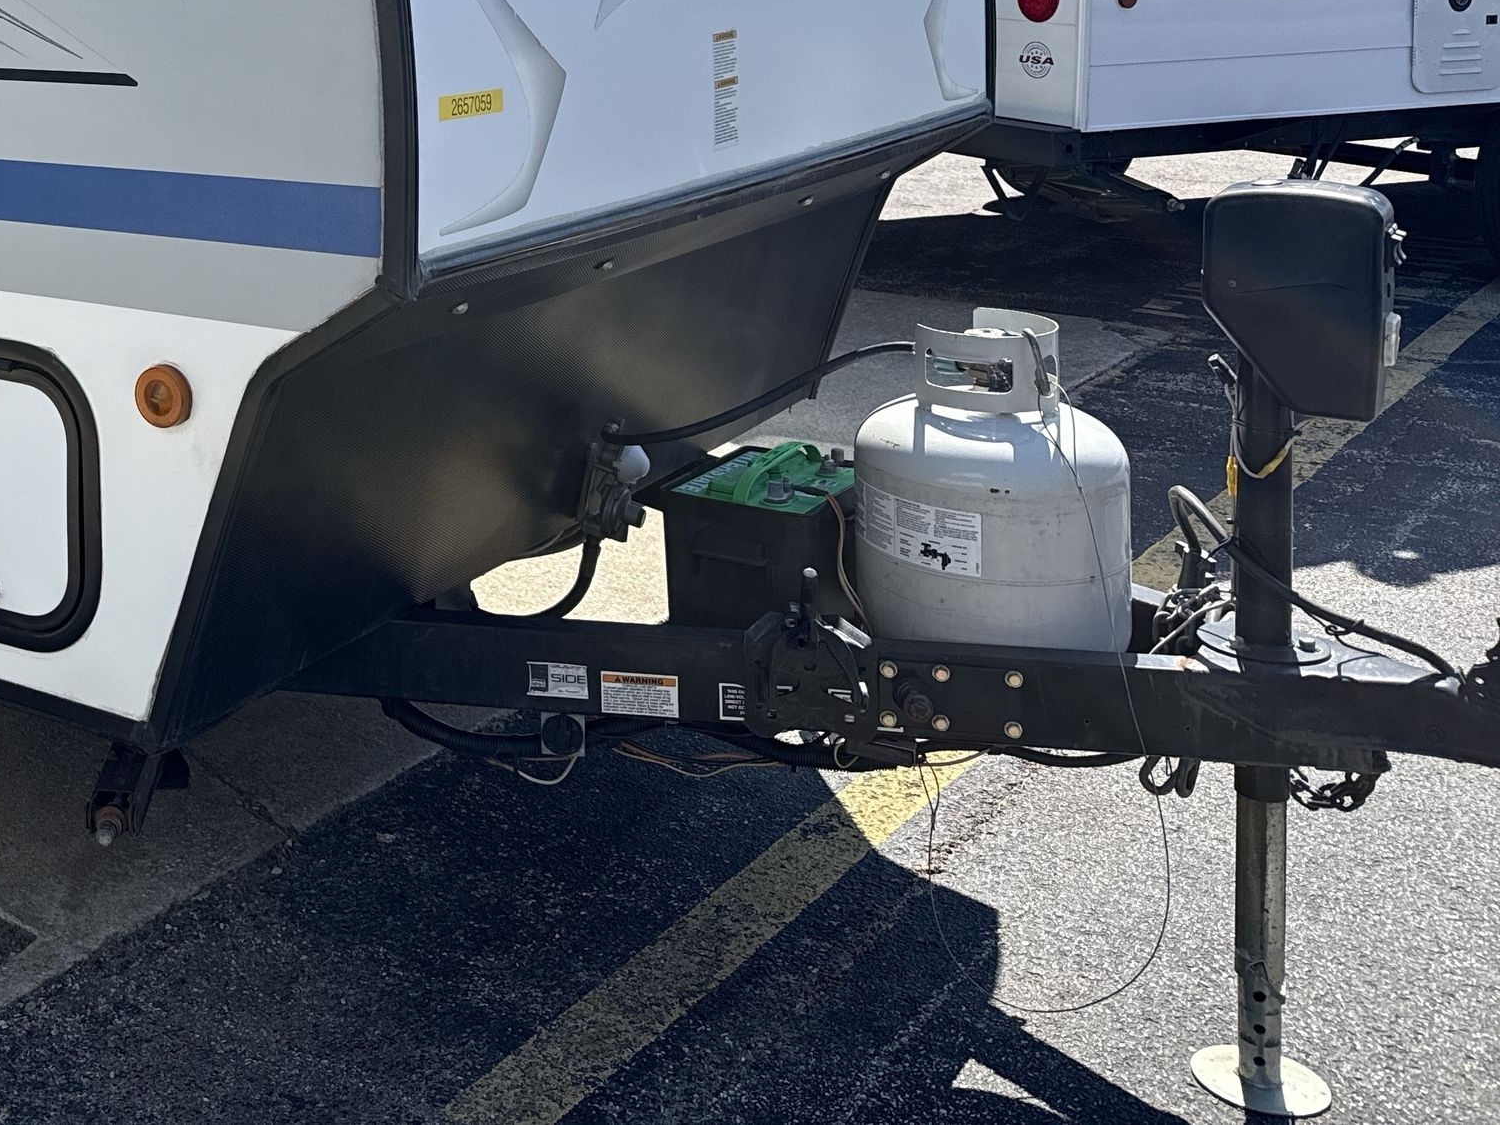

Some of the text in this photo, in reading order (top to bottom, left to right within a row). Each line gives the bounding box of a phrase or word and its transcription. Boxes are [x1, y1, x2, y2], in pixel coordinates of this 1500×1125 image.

[1019, 55, 1055, 66] USA
[450, 93, 493, 116] 2657059
[551, 674, 587, 685] SIDE
[622, 676, 664, 685] WARNING
